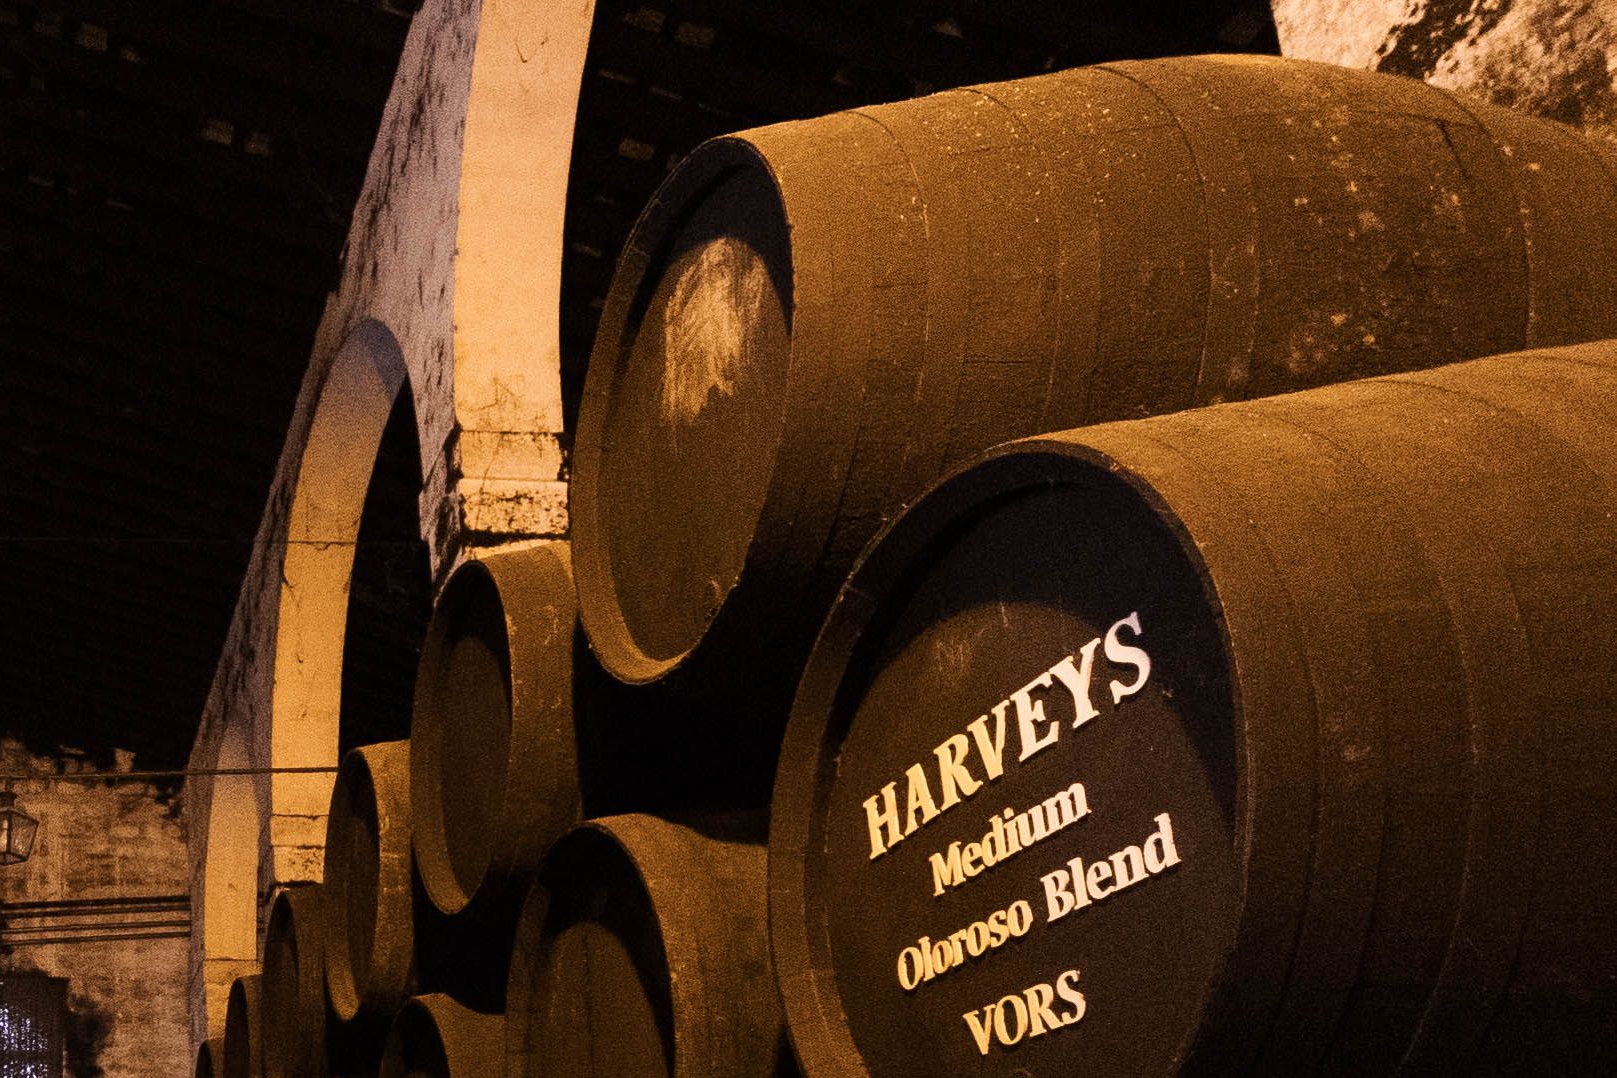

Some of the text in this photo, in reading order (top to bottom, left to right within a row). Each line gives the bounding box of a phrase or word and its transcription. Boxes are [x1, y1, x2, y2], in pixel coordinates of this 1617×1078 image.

[863, 611, 1151, 860] HARVEYS
[897, 812, 1181, 991] Oloroso Blend
[929, 782, 1092, 897] Medium
[962, 969, 1086, 1055] VORS
